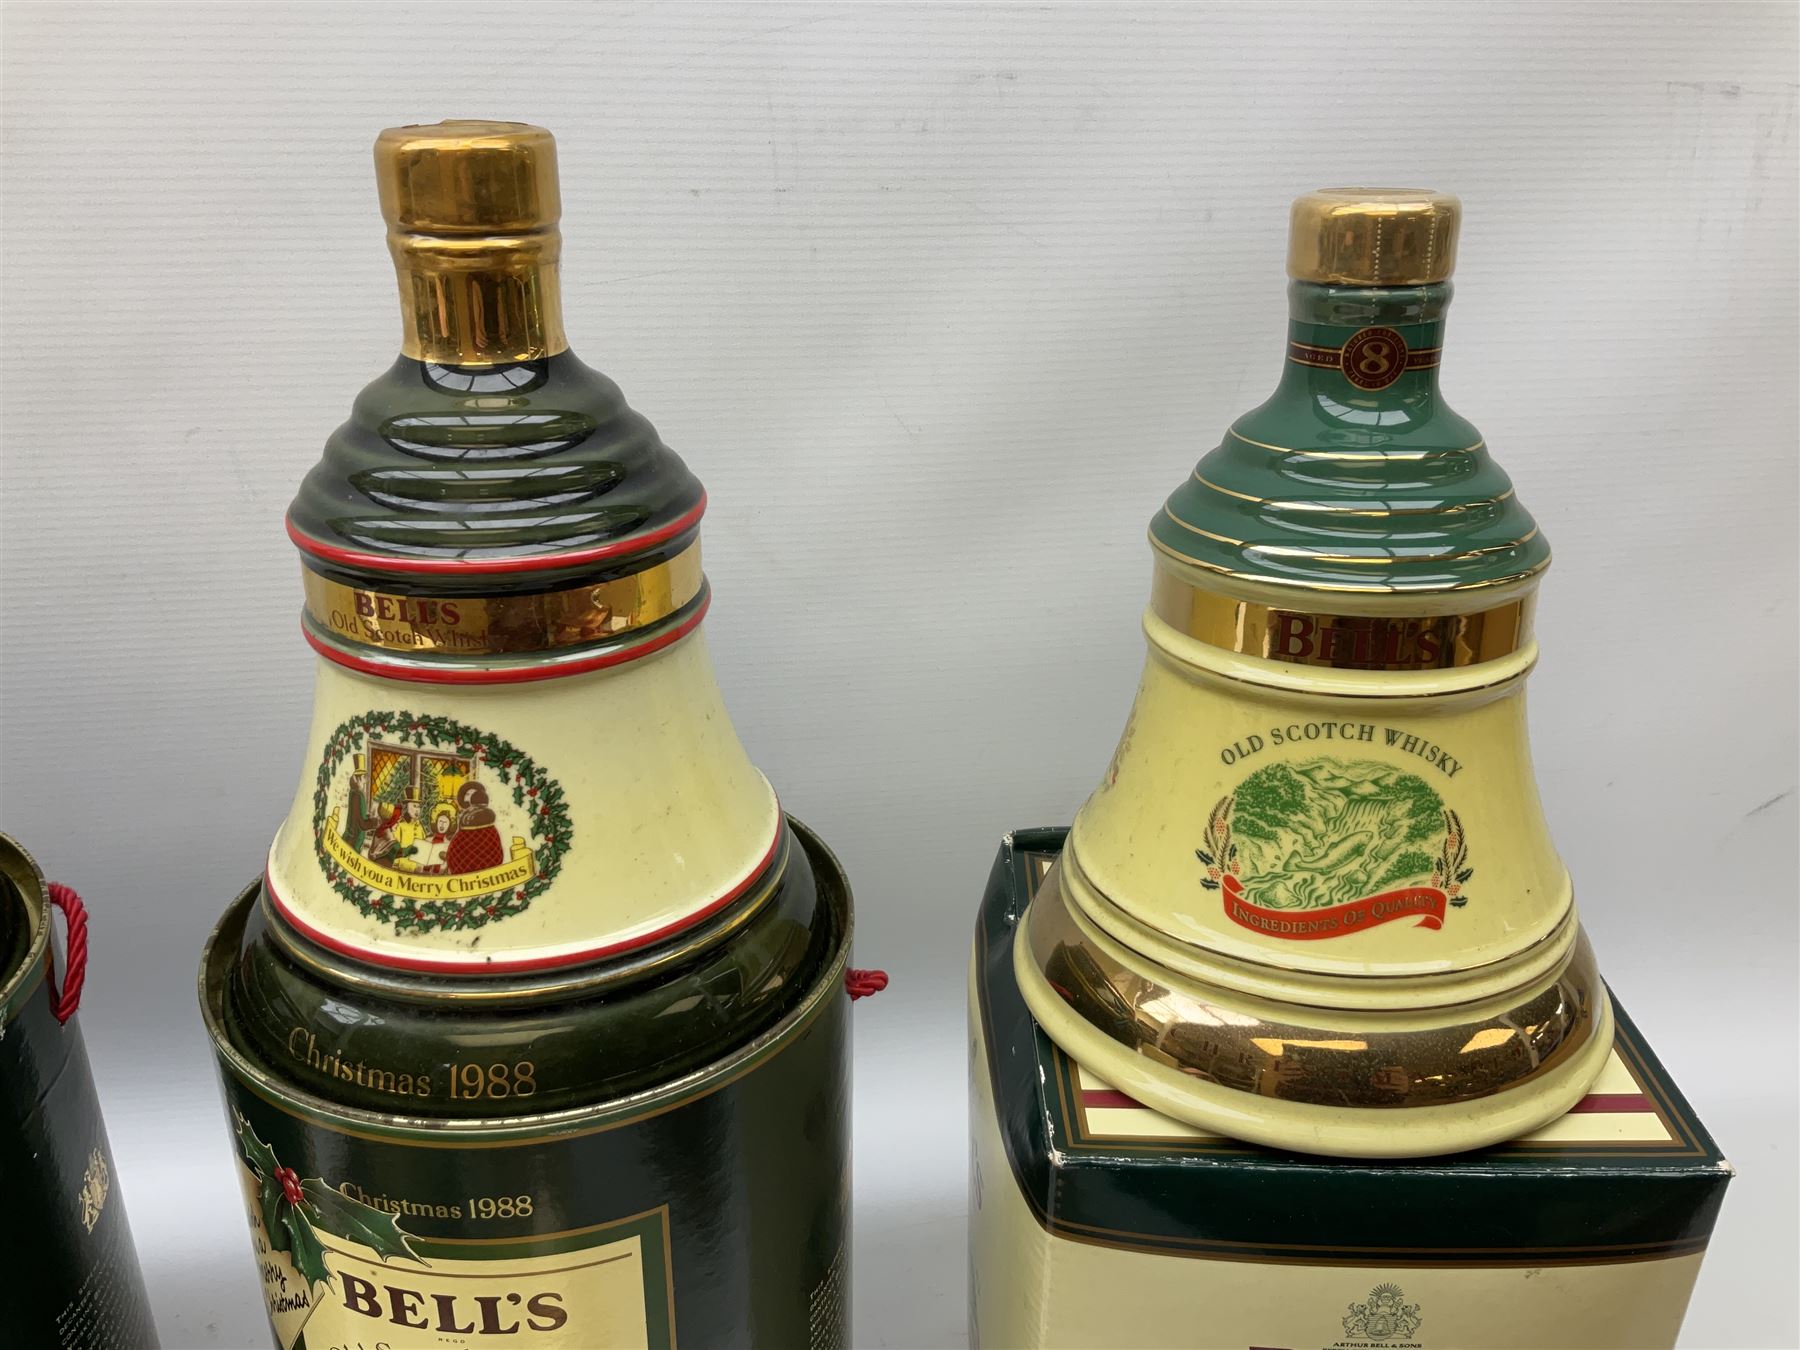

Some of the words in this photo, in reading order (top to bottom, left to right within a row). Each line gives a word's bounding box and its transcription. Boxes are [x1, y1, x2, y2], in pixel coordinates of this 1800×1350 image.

[1360, 341, 1390, 374] 8
[332, 609, 358, 635] Old
[363, 619, 424, 646] Scotch
[353, 591, 461, 625] BELL'S
[1276, 614, 1441, 665] BELL'S
[1220, 734, 1264, 765] OLD
[1270, 722, 1376, 746] SCOTCH
[1384, 727, 1463, 779] WHISKY
[327, 828, 340, 852] We
[340, 848, 361, 872] wish
[360, 866, 383, 883] you
[384, 876, 393, 888] a
[397, 876, 443, 897] Merry
[447, 865, 528, 892] Christmas
[1232, 902, 1338, 934] INGREDIENTS
[288, 1027, 431, 1096] Christmas
[450, 1061, 537, 1099] 1988
[340, 1182, 462, 1219] Christmas
[468, 1195, 535, 1219] 1988
[337, 1270, 568, 1334] BELL'S
